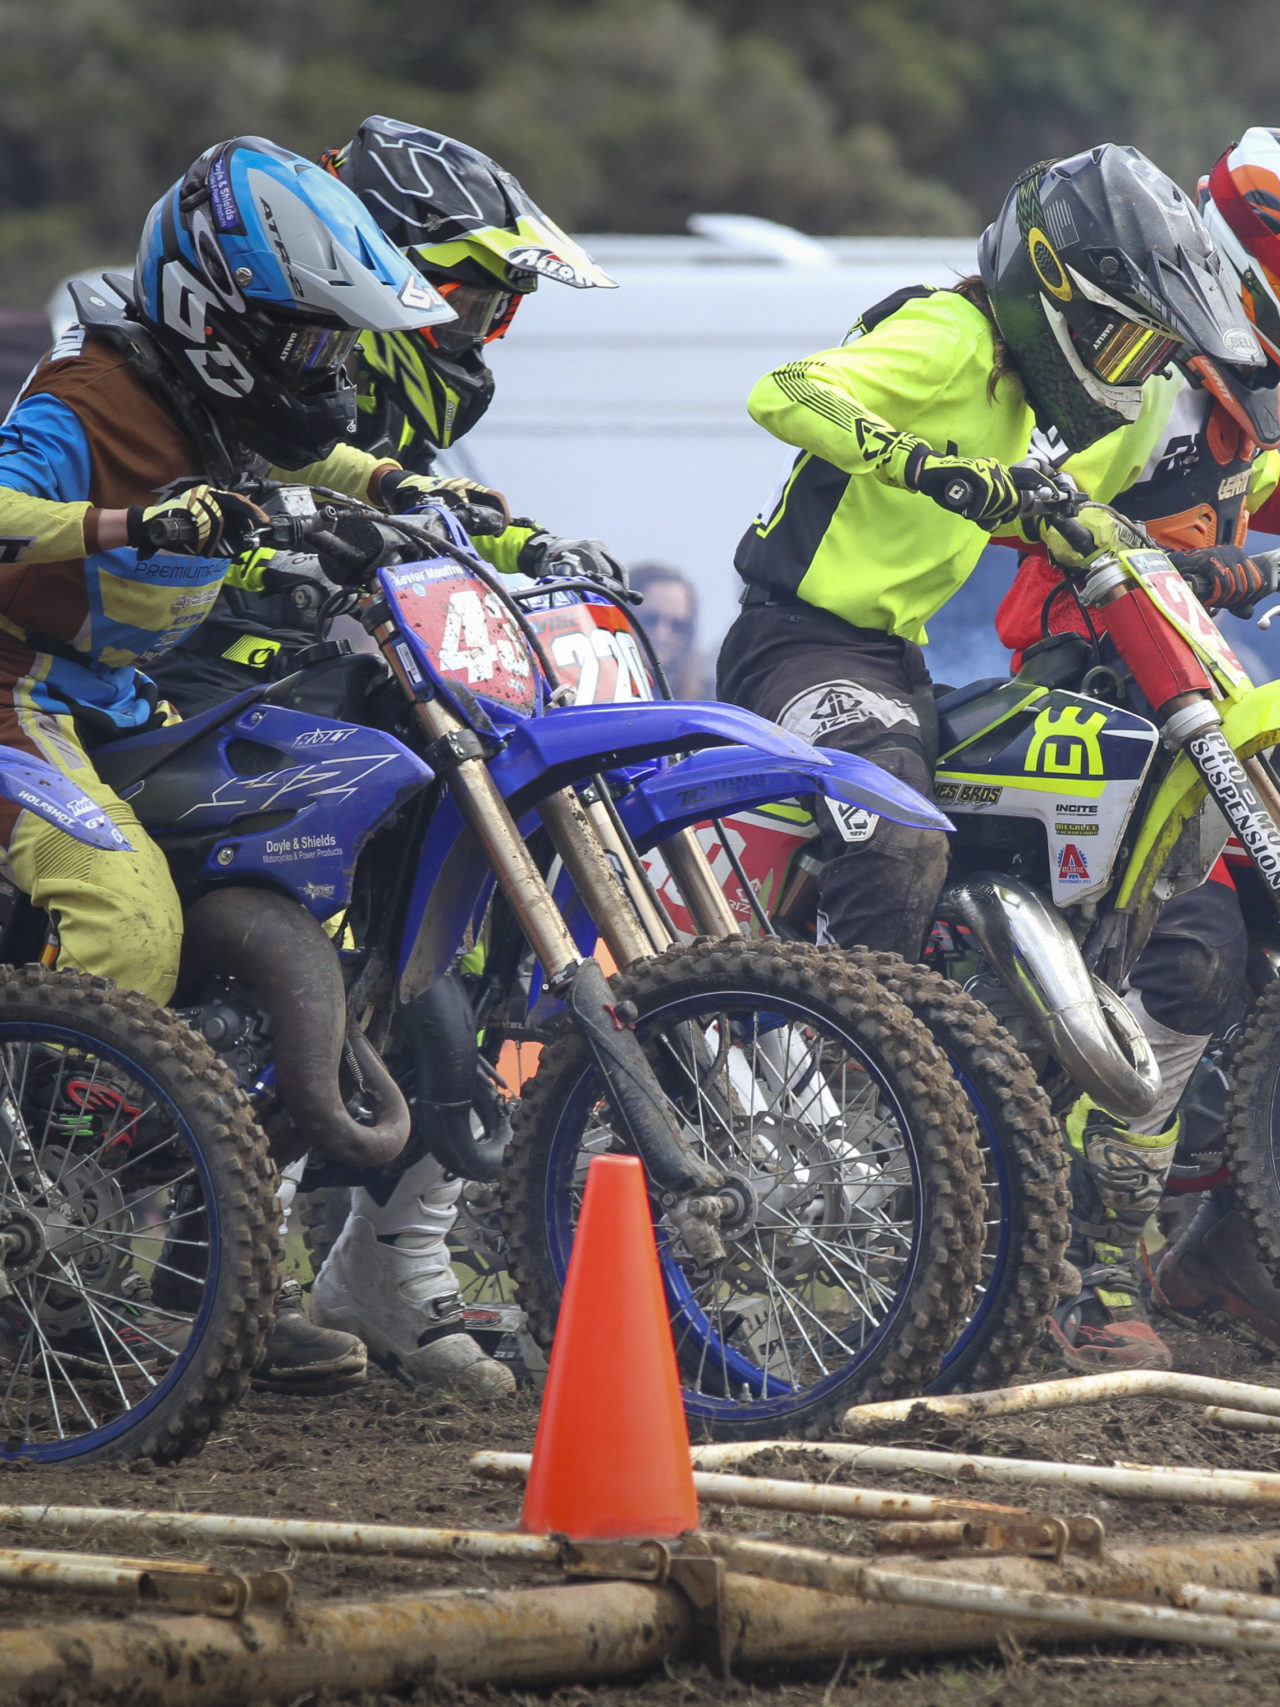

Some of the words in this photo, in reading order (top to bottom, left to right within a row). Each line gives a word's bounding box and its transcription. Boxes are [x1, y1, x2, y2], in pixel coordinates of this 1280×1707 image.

[279, 332, 298, 362] OAKLEY
[1093, 323, 1114, 351] OAKLEY
[392, 571, 425, 586] Xavier
[1205, 731, 1248, 783] PRO
[1055, 803, 1099, 813] INCITE
[266, 839, 291, 855] Doyle
[293, 837, 300, 850] &
[301, 834, 337, 849] Shields
